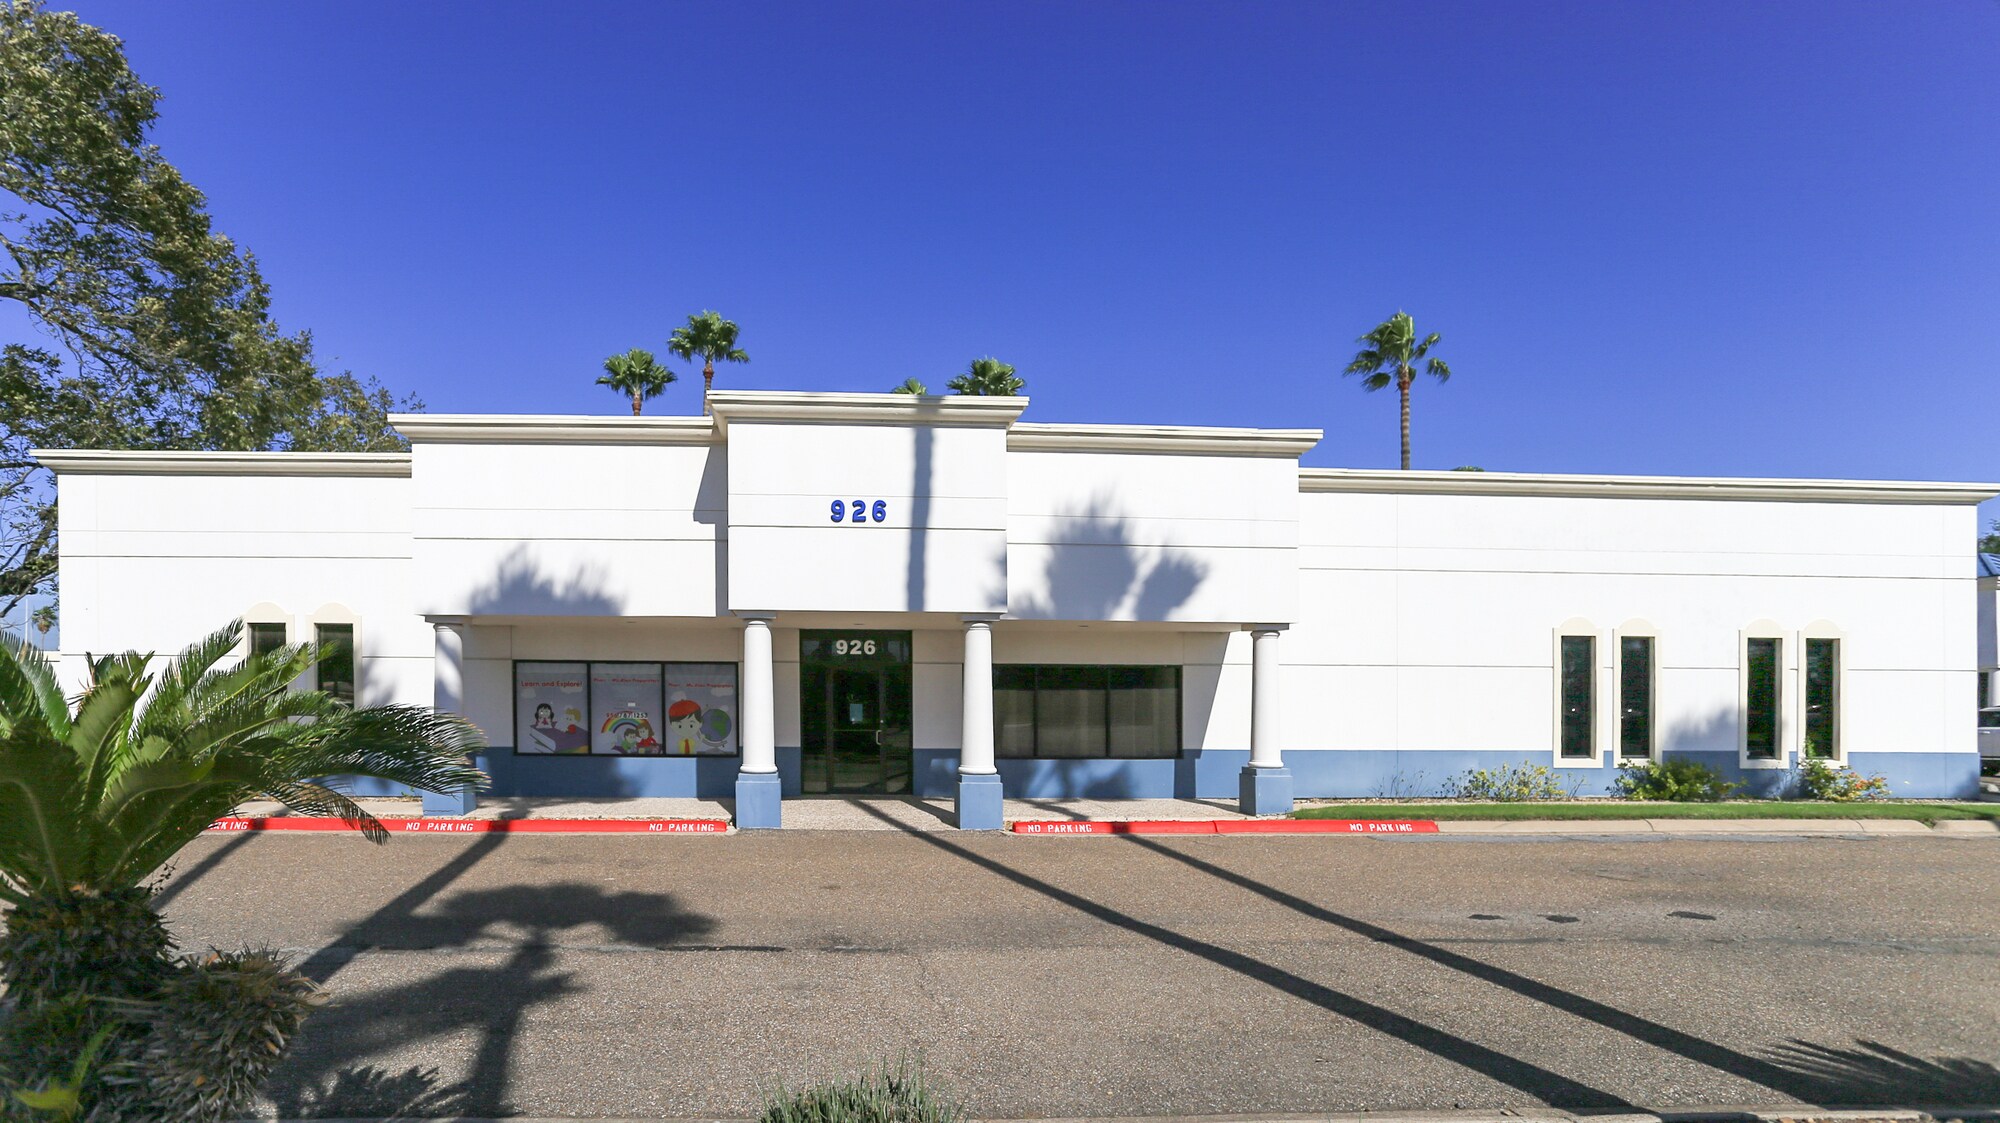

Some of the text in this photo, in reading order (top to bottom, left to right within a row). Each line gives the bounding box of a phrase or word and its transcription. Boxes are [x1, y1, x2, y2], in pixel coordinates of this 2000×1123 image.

[831, 500, 887, 523] 926
[836, 640, 876, 655] 926
[520, 680, 540, 688] Learn
[542, 680, 555, 688] and
[207, 821, 249, 830] RKING
[405, 822, 474, 832] NO PARKING
[648, 823, 715, 832] NO PARKING
[1027, 823, 1093, 834] NO PARKING
[1349, 823, 1413, 832] NO PARKING
